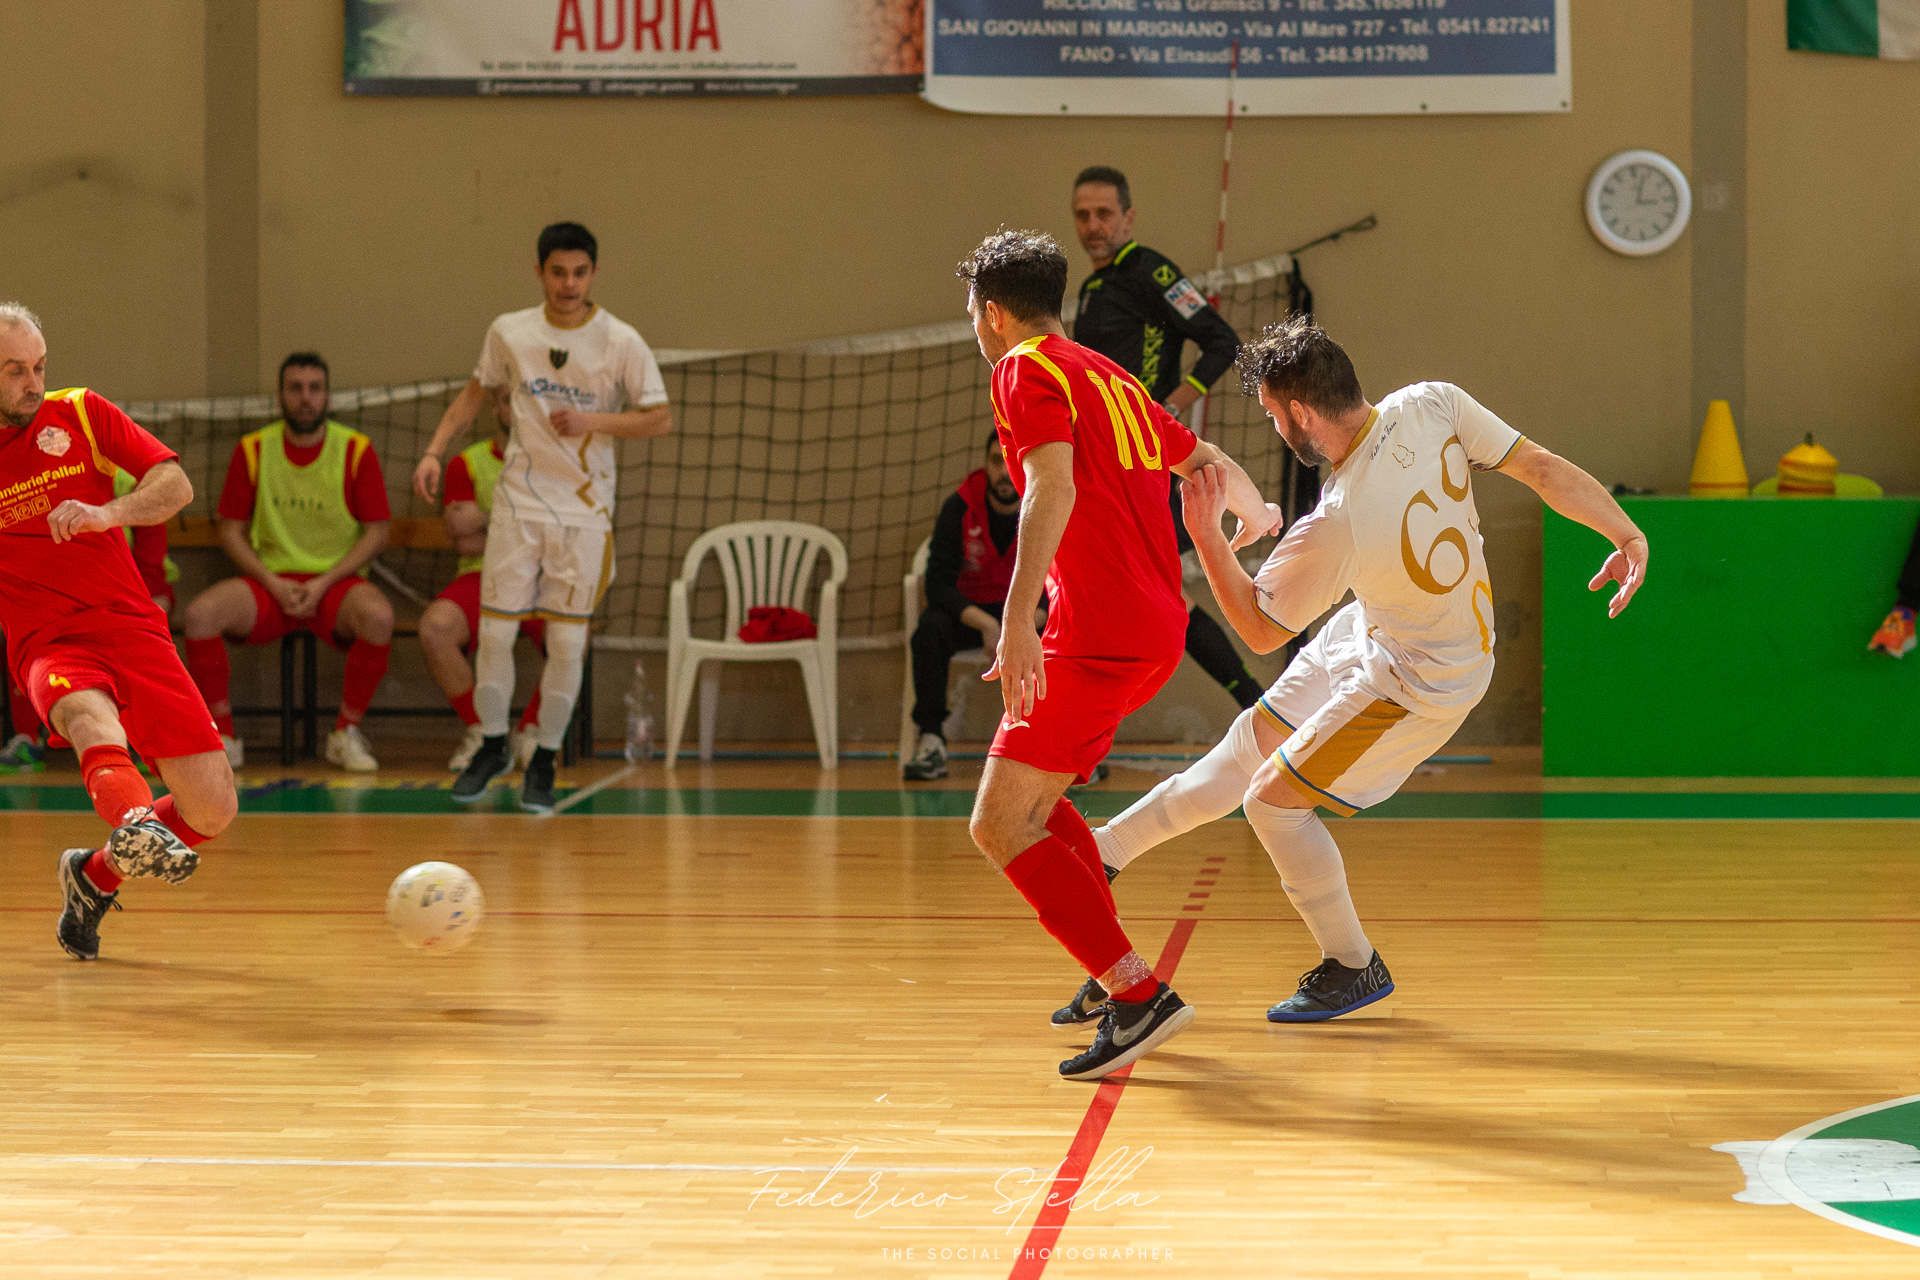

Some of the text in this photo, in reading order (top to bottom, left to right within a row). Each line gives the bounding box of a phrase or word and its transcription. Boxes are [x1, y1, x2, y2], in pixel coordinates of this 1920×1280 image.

[1043, 0, 1138, 11] RICCIONE
[553, 0, 721, 52] ADRIA
[937, 18, 979, 36] SAN
[983, 19, 1077, 36] GIOVANNI
[1082, 20, 1101, 36] IN
[1106, 20, 1229, 37] MARIGNANO
[1243, 20, 1274, 37] Via
[1301, 20, 1348, 37] Mare
[1353, 19, 1385, 36] 727
[1400, 18, 1434, 36] Tel.
[1060, 45, 1115, 63] FANO
[1130, 46, 1160, 63] Via
[1278, 46, 1311, 64] Tel.
[1084, 368, 1163, 471] 10
